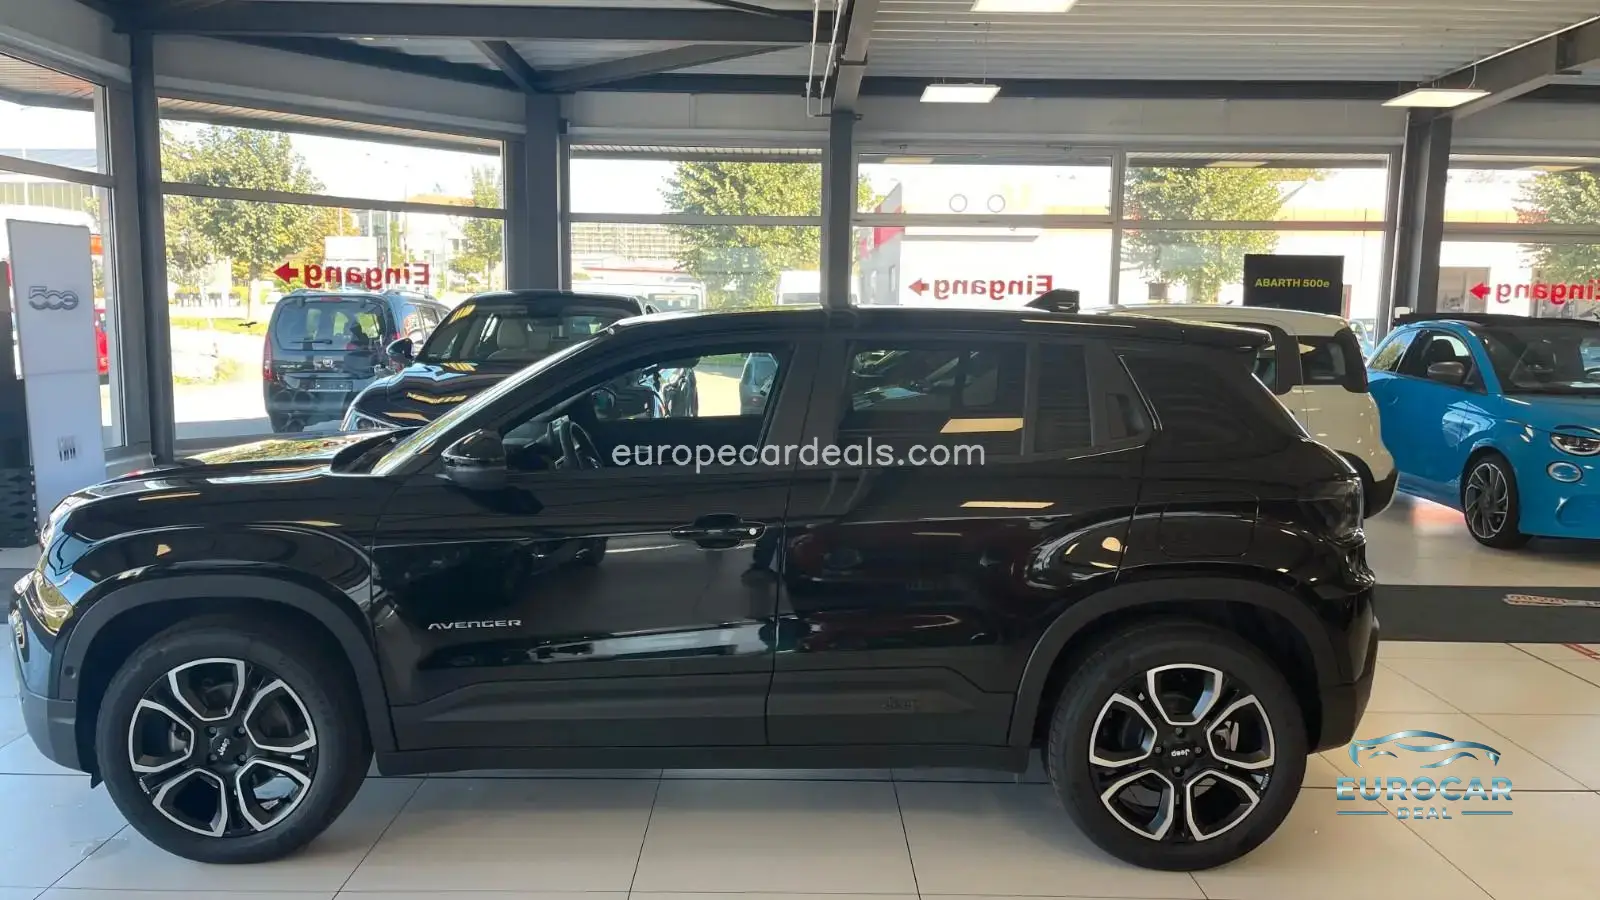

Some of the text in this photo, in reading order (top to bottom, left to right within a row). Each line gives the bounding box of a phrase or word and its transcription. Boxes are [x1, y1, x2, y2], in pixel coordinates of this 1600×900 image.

[1255, 277, 1330, 288] ABARTH 500e
[427, 619, 522, 630] AVENGER
